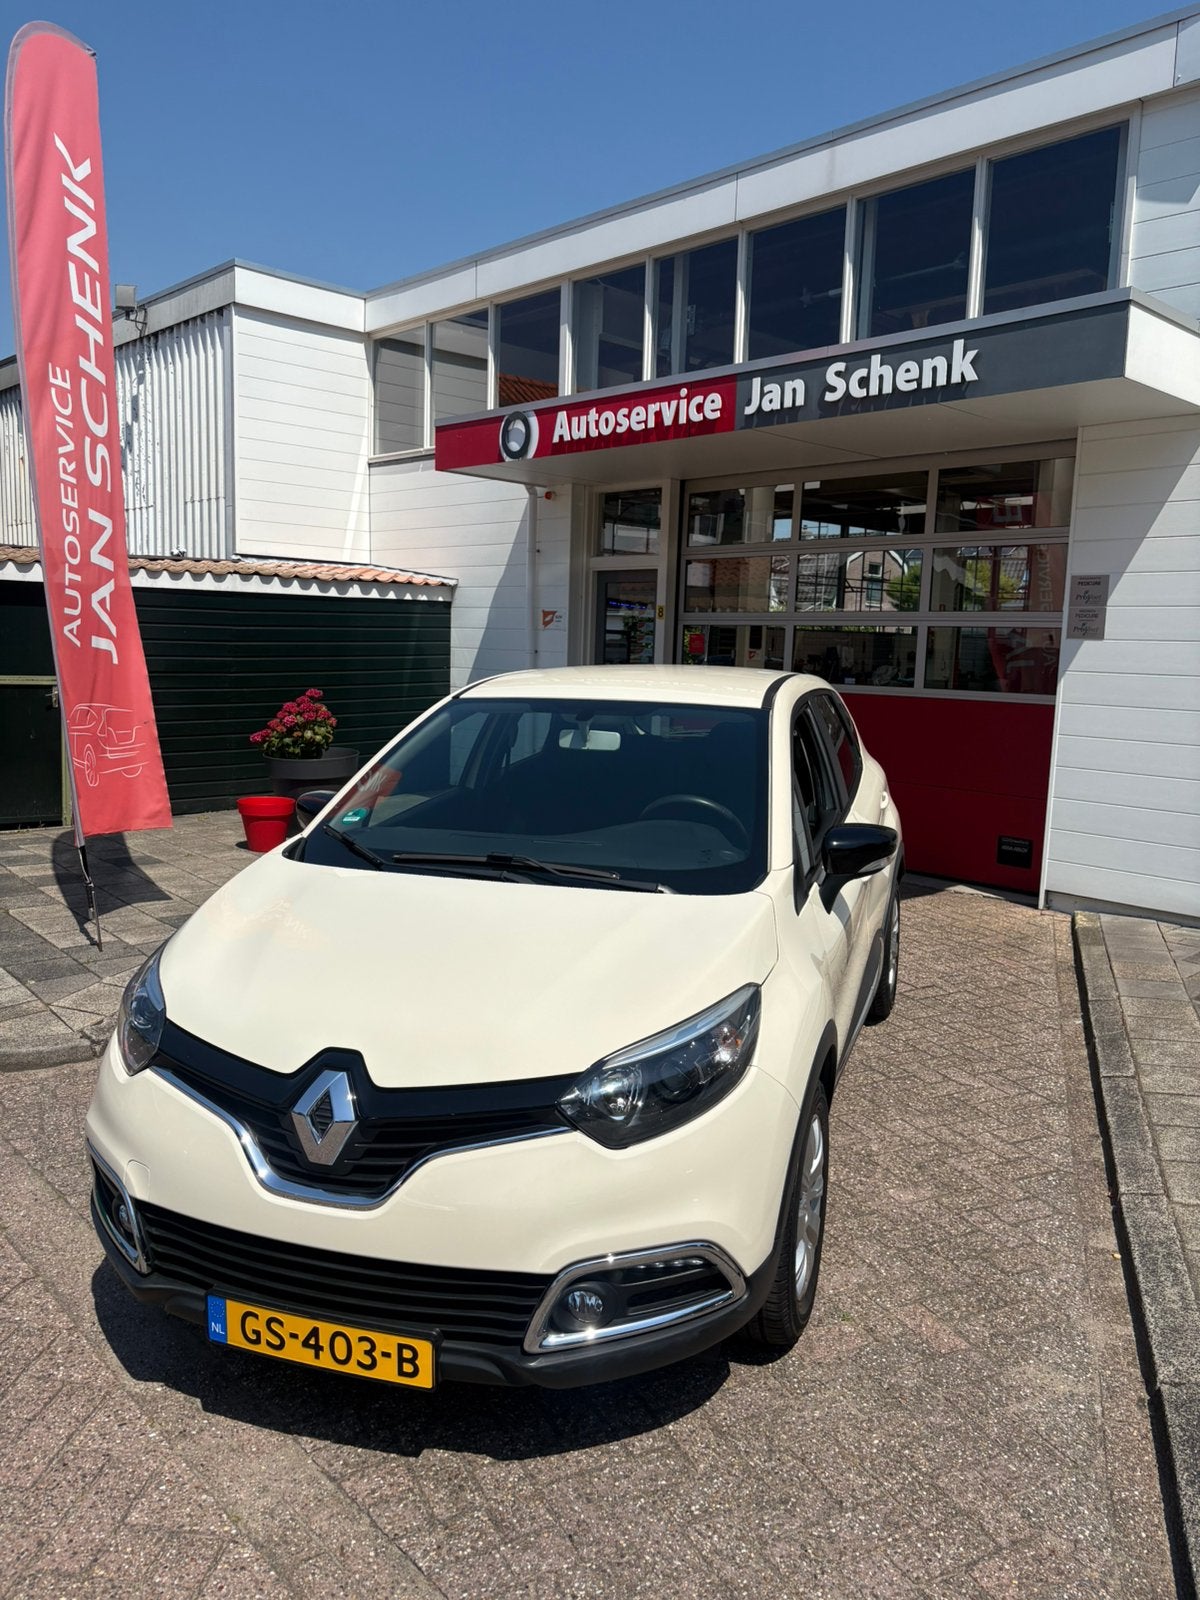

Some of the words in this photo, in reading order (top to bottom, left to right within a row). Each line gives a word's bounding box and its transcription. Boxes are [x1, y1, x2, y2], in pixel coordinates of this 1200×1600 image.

[53, 132, 112, 492] SCHENK
[744, 376, 805, 416] Jan
[824, 338, 980, 401] Schenk
[552, 388, 722, 444] Autoservice
[48, 362, 82, 648] AUTOSERVICE
[88, 508, 119, 665] JAN
[657, 606, 664, 618] 8
[211, 1322, 225, 1335] NL
[240, 1310, 420, 1379] GS-403-B
